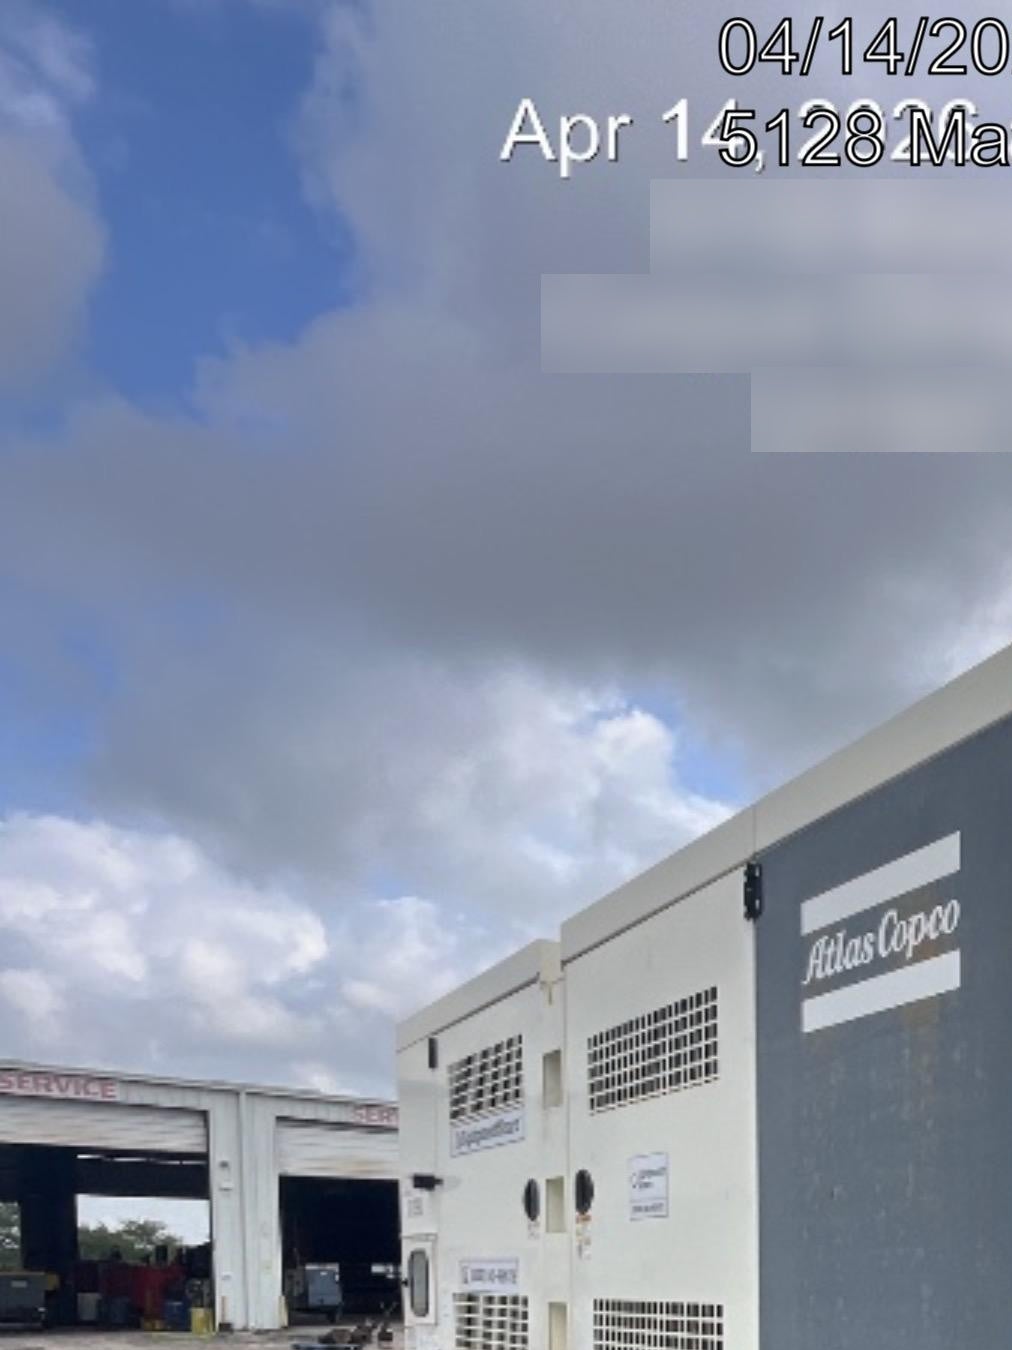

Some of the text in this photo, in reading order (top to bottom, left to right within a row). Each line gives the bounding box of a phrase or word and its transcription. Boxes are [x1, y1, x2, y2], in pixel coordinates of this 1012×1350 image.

[801, 899, 961, 985] Atlas Copco
[0, 1072, 117, 1099] SERVICE
